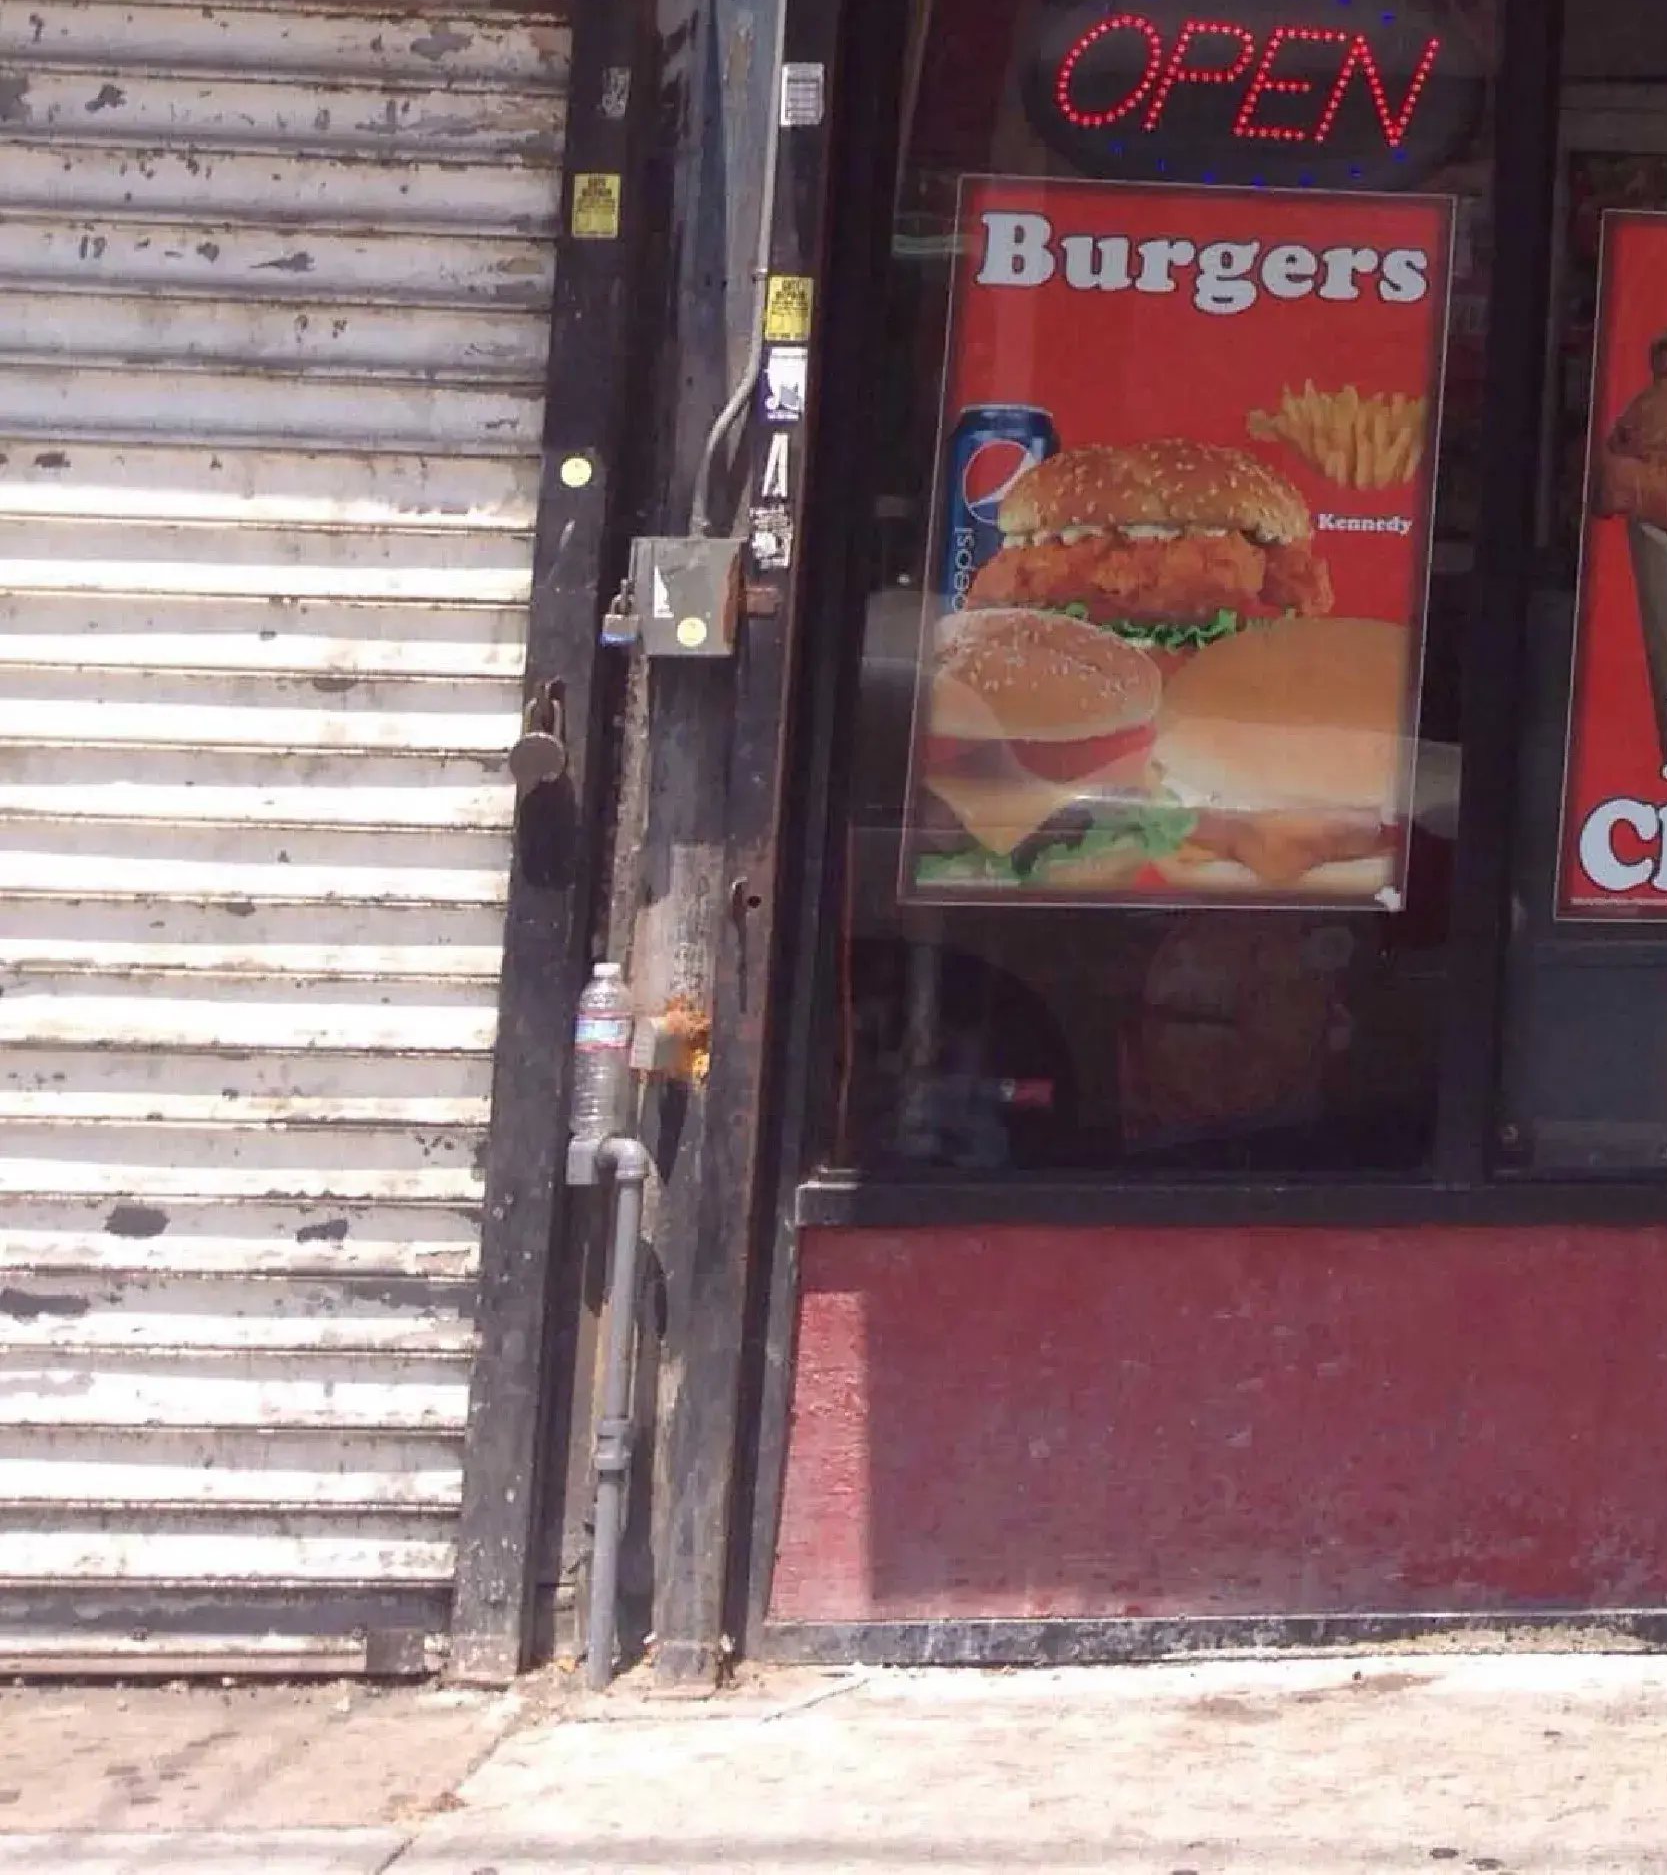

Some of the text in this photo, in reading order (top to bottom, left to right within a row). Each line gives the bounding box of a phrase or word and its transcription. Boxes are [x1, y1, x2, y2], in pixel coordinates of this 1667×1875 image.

[1056, 12, 1439, 147] OPEN
[976, 211, 1428, 315] Burgers
[1318, 513, 1413, 538] Kennedy
